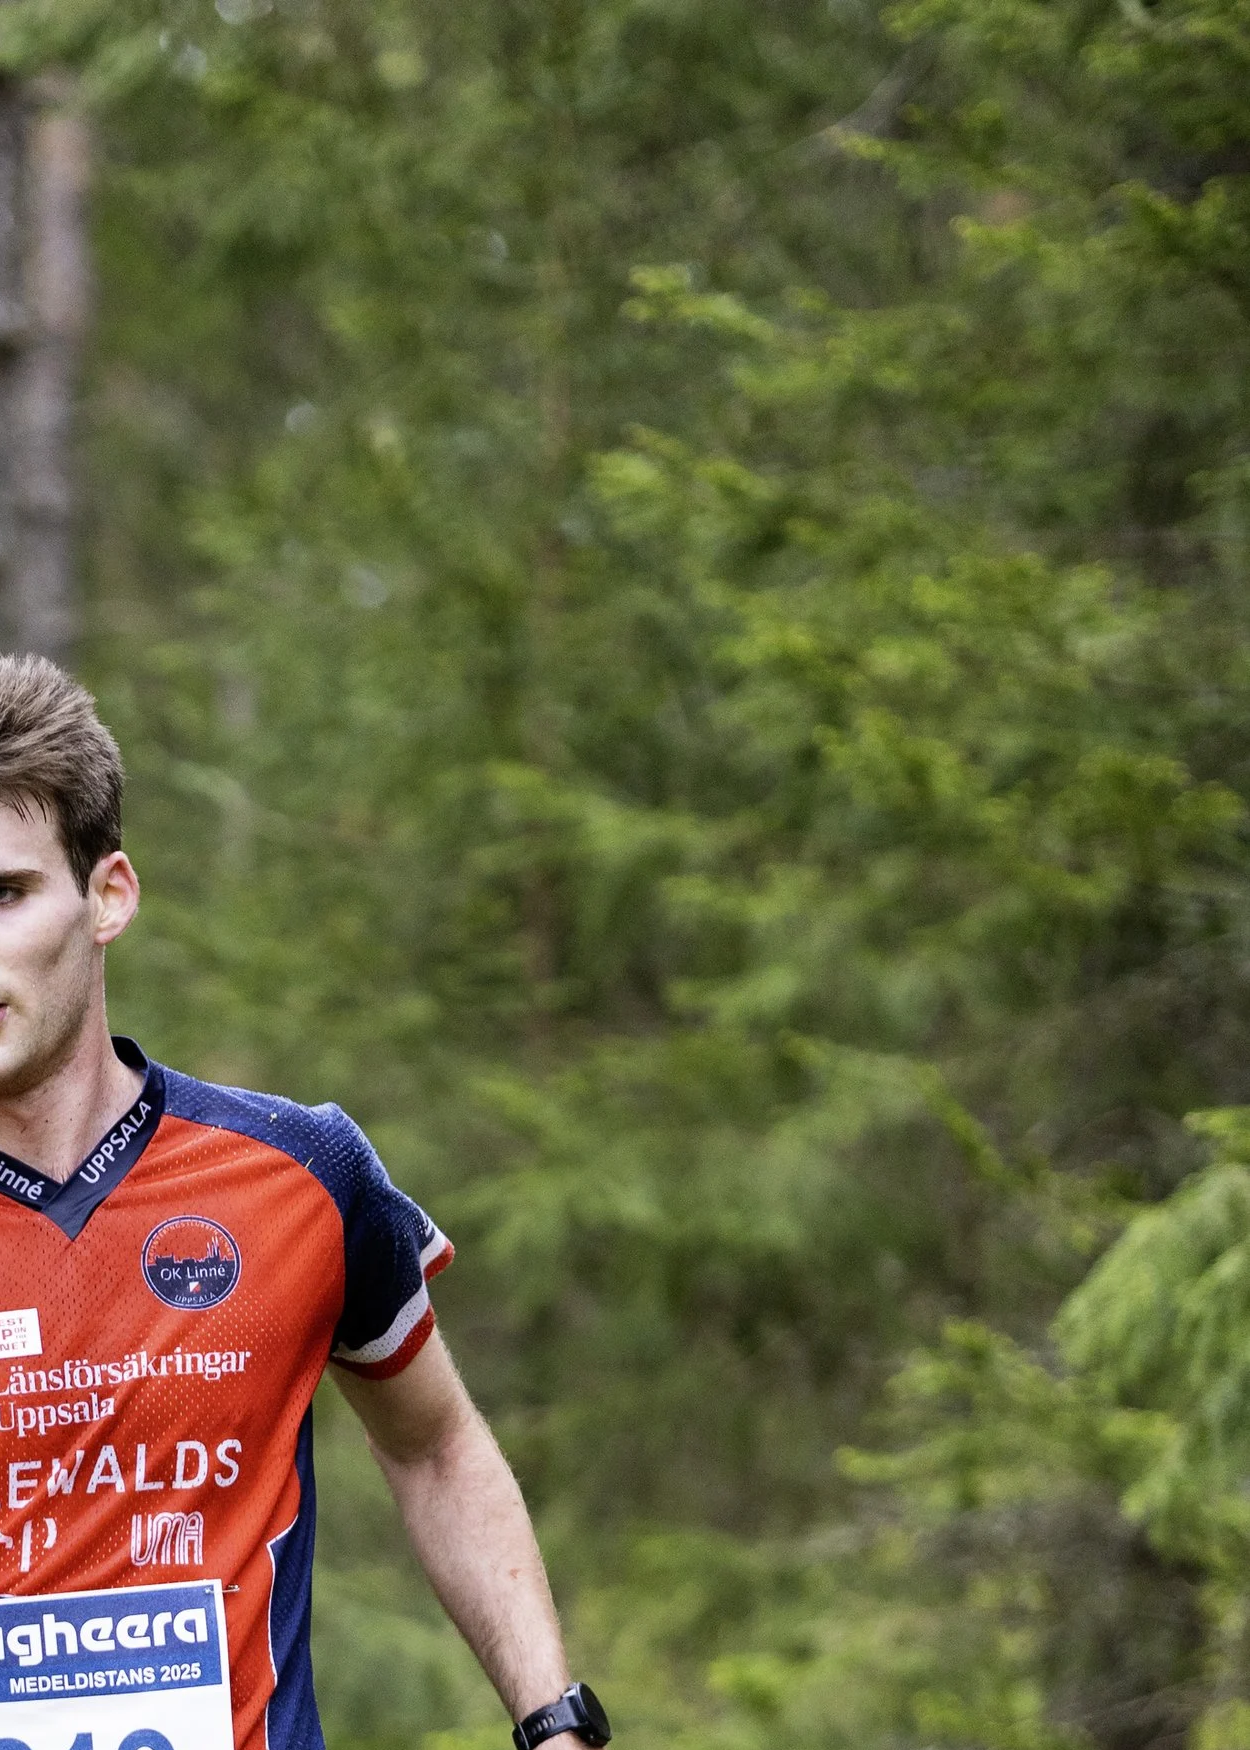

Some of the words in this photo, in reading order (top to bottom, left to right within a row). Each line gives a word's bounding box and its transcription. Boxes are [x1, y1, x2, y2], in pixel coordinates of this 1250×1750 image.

[79, 1100, 152, 1184] UPPSALA
[160, 1267, 182, 1281] OK
[187, 1264, 226, 1279] Linné
[174, 1292, 217, 1304] UPPSALA
[9, 1667, 156, 1695] MEDELDISTANS
[160, 1661, 202, 1683] 2025
